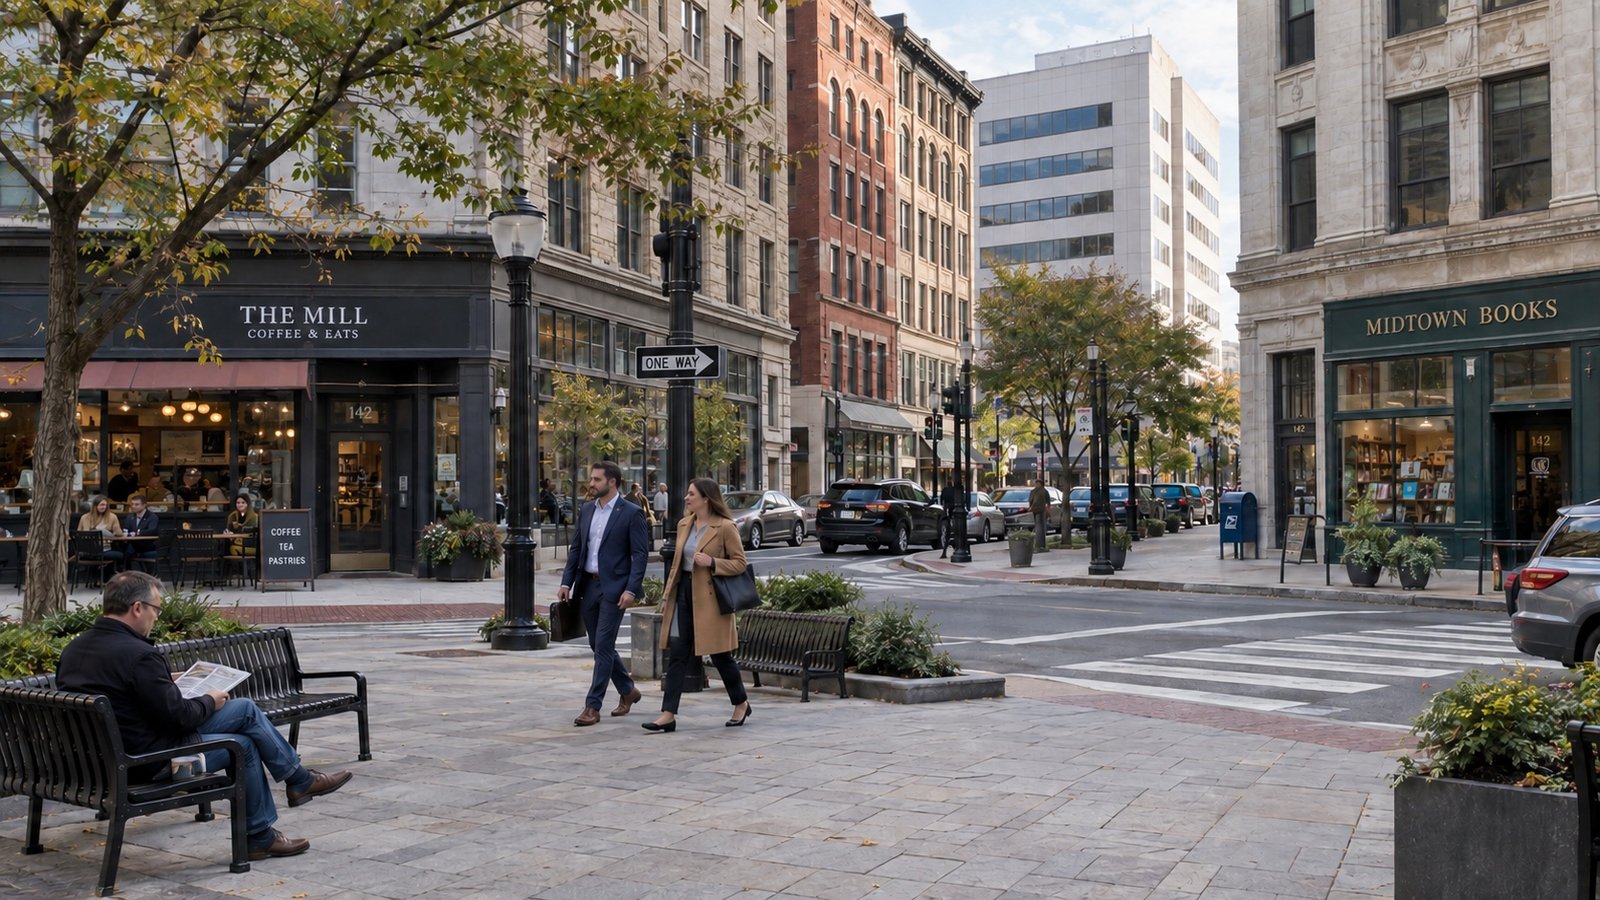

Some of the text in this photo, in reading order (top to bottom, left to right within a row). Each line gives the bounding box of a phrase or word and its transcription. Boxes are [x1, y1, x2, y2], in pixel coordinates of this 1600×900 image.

[239, 305, 368, 325] THE MILL
[1365, 298, 1558, 337] MIDTOWN BOOKS
[247, 328, 359, 339] COFFEE & EATS
[645, 355, 700, 370] ONE WAY
[349, 405, 373, 420] 142
[1531, 434, 1551, 447] 142
[270, 527, 302, 537] COFFEE
[279, 542, 294, 551] TEA
[268, 556, 306, 565] PASTRIES
